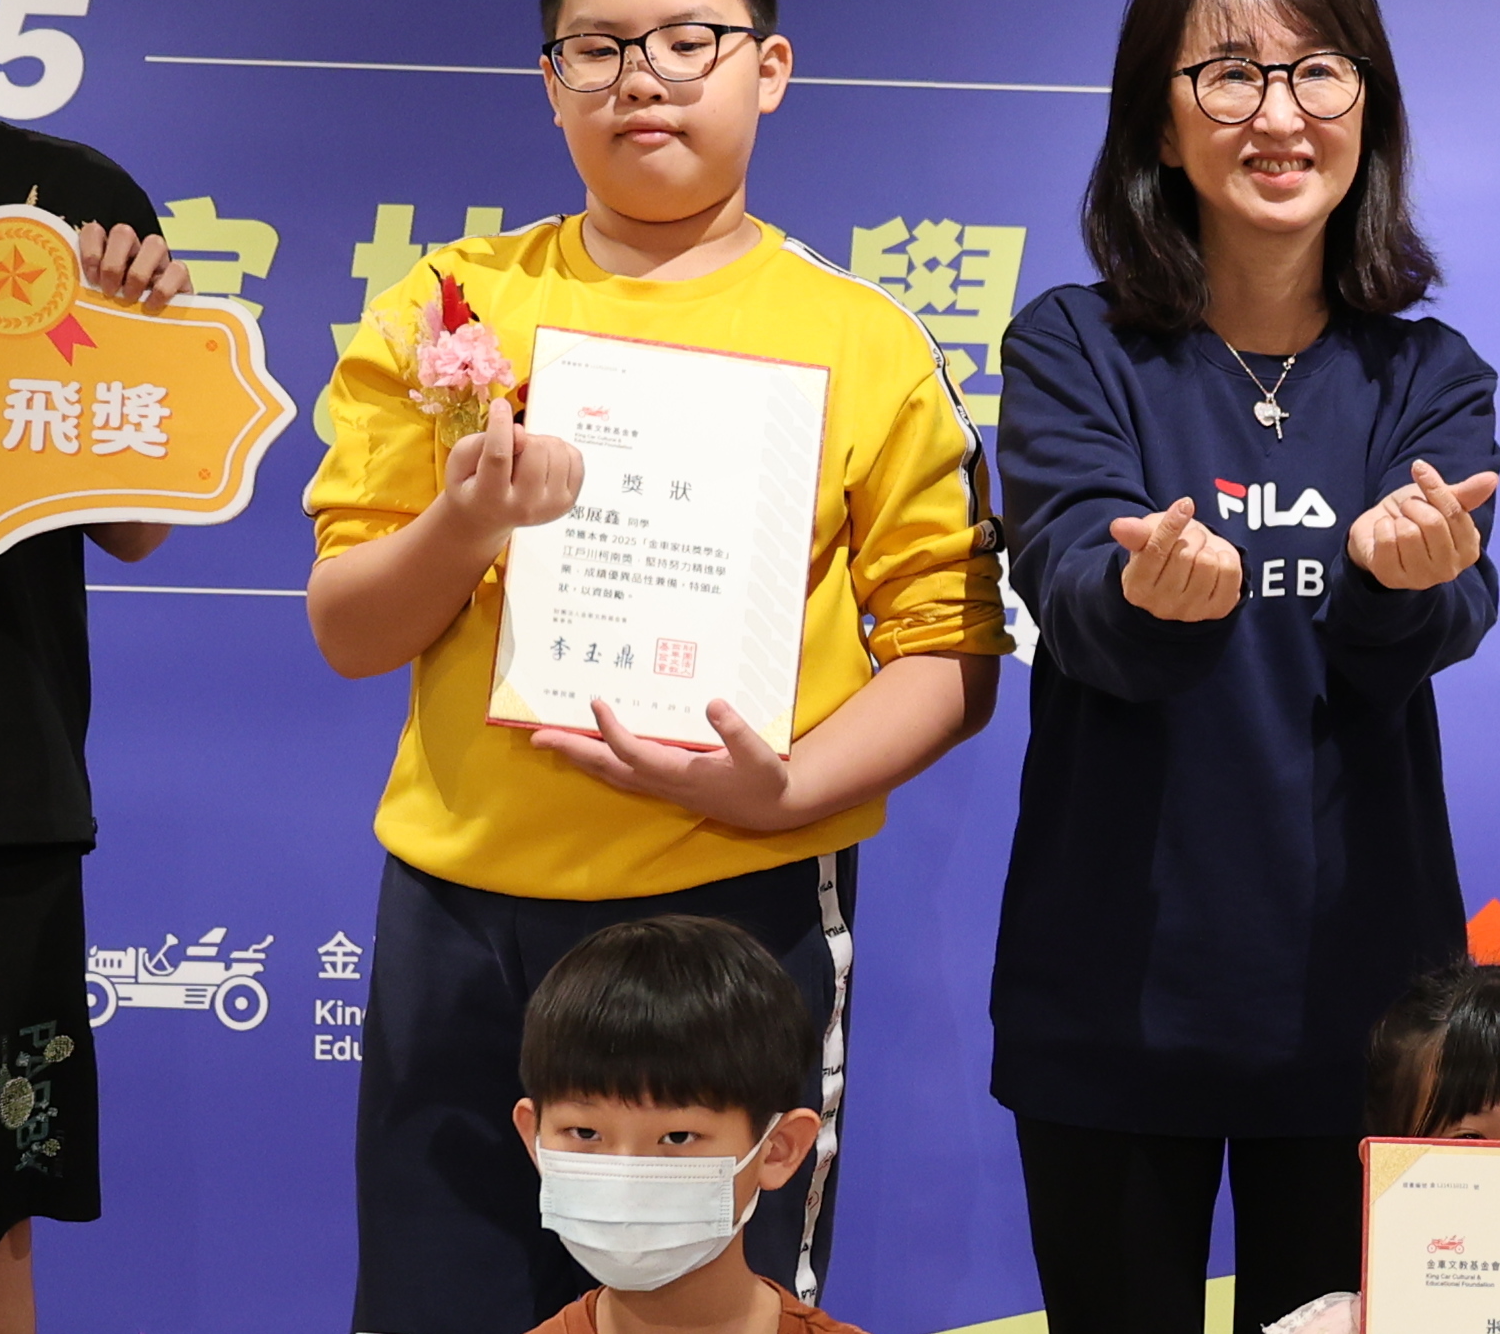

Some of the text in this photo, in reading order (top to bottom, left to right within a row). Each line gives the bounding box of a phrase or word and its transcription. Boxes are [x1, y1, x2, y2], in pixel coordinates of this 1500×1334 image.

[1215, 478, 1337, 530] FILA
[627, 517, 650, 530] 同學
[1427, 1259, 1500, 1272] 金車文教基金會
[1426, 1273, 1438, 1281] King
[1426, 1280, 1459, 1288] Educational
